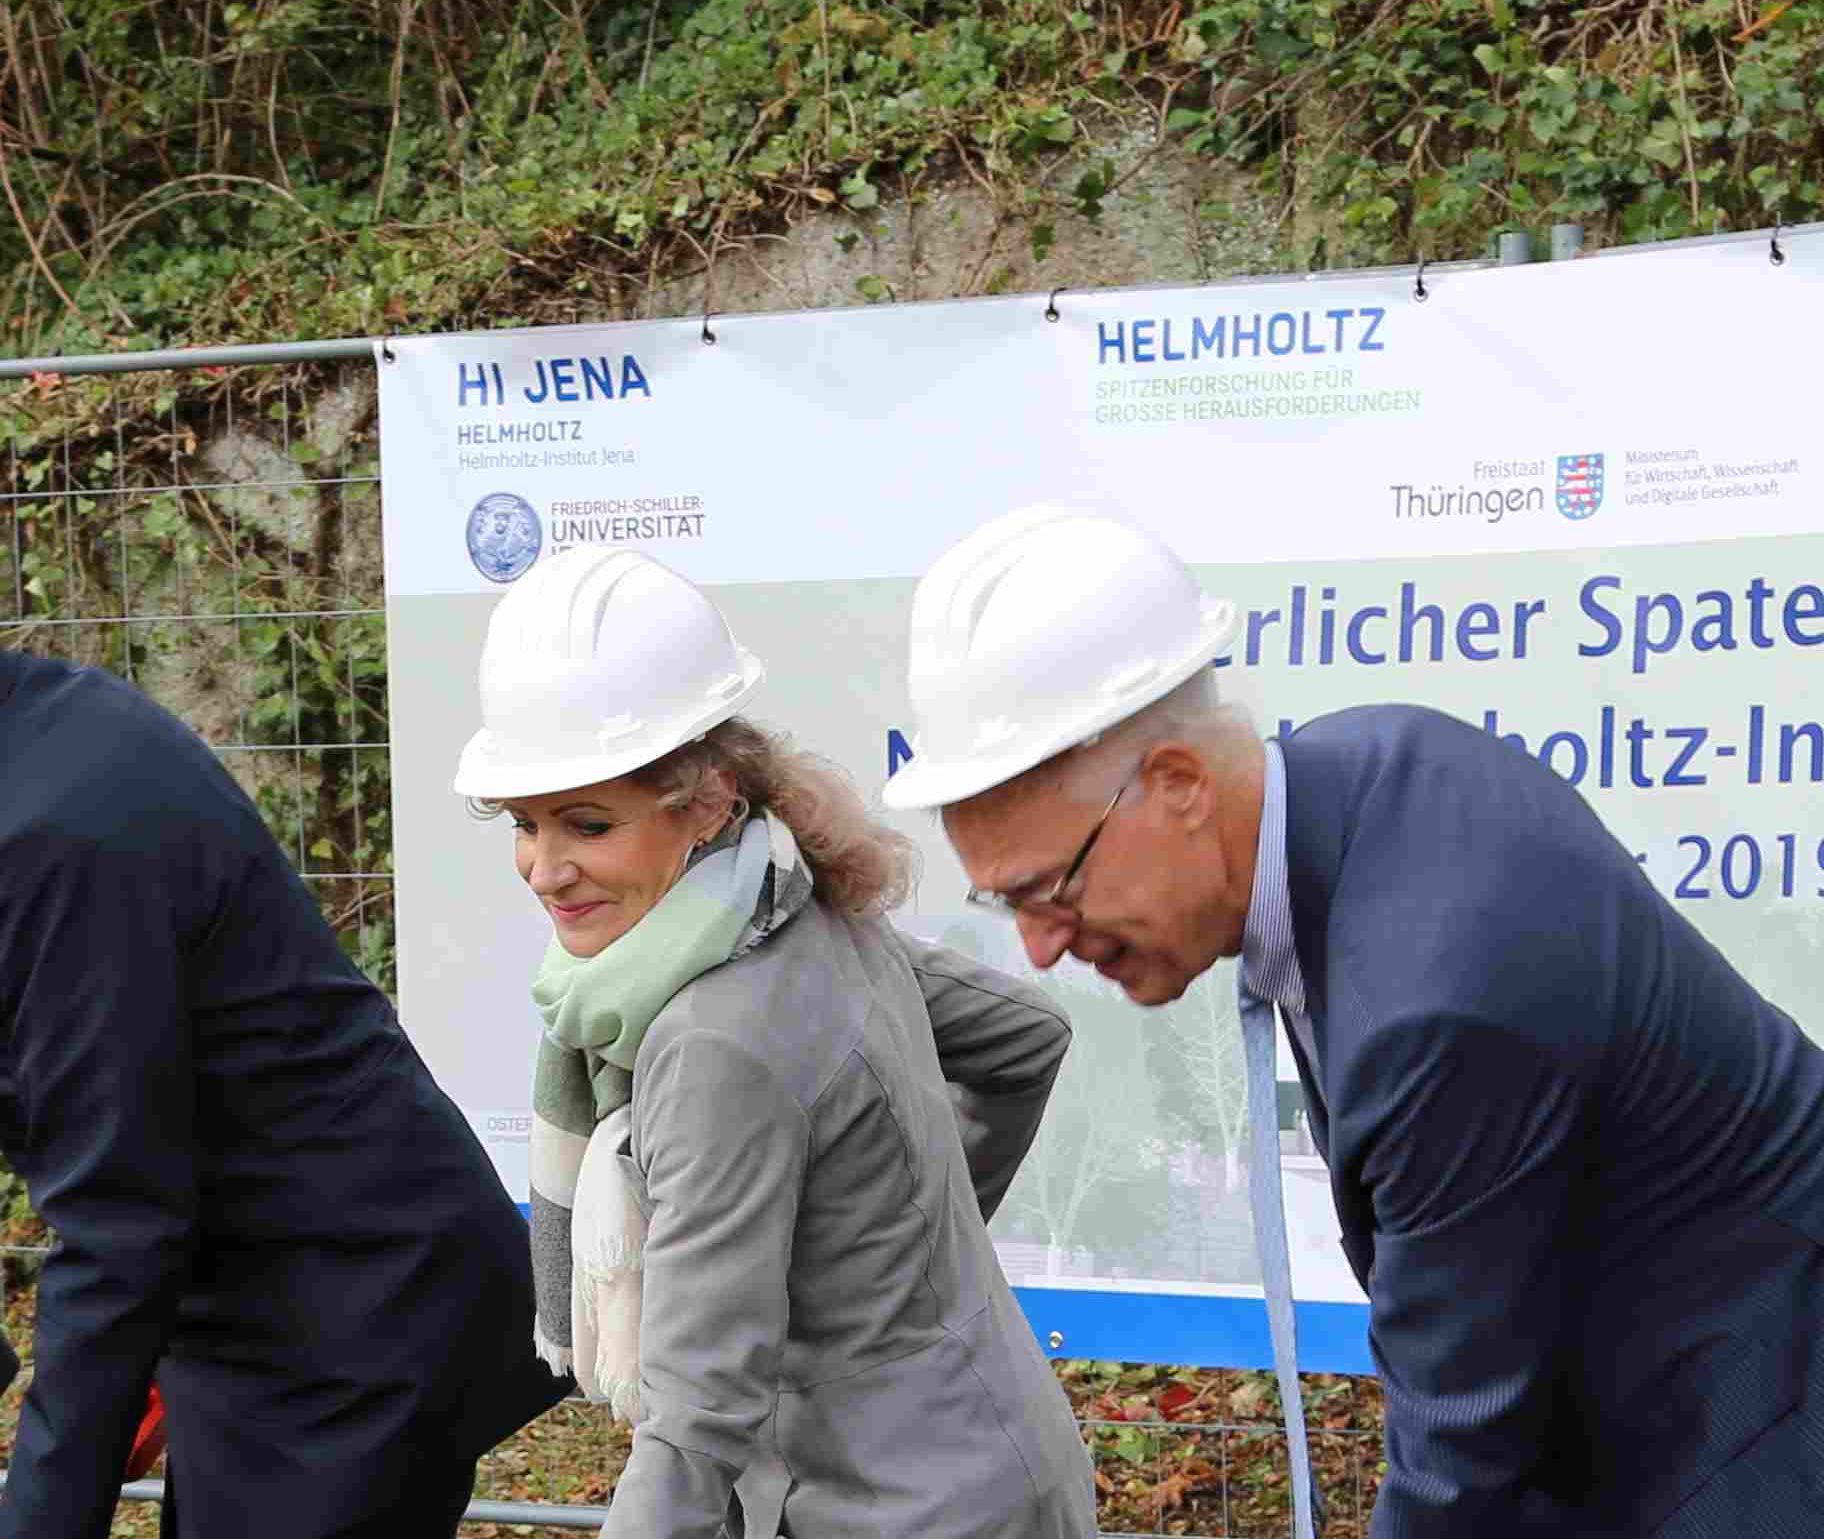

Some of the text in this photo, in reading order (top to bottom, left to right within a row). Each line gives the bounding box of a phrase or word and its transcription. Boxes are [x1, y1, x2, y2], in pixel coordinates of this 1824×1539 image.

[1098, 307, 1386, 364] HELMHOLTZ
[458, 354, 651, 406] HI JENA
[1095, 366, 1354, 399] SPITZENFORSCHUNG FÜR
[1095, 389, 1422, 425] GROSSE HERAUSFORDERUNGEN
[457, 420, 583, 445] HELMHOLTZ
[459, 447, 635, 470] Helmholtz-Institut Jena
[1473, 459, 1545, 481] Freistaat
[551, 496, 705, 516] FRIEDRICH-SCHILLER-
[1389, 483, 1545, 524] Thüringen
[1212, 581, 1546, 668] rlicher
